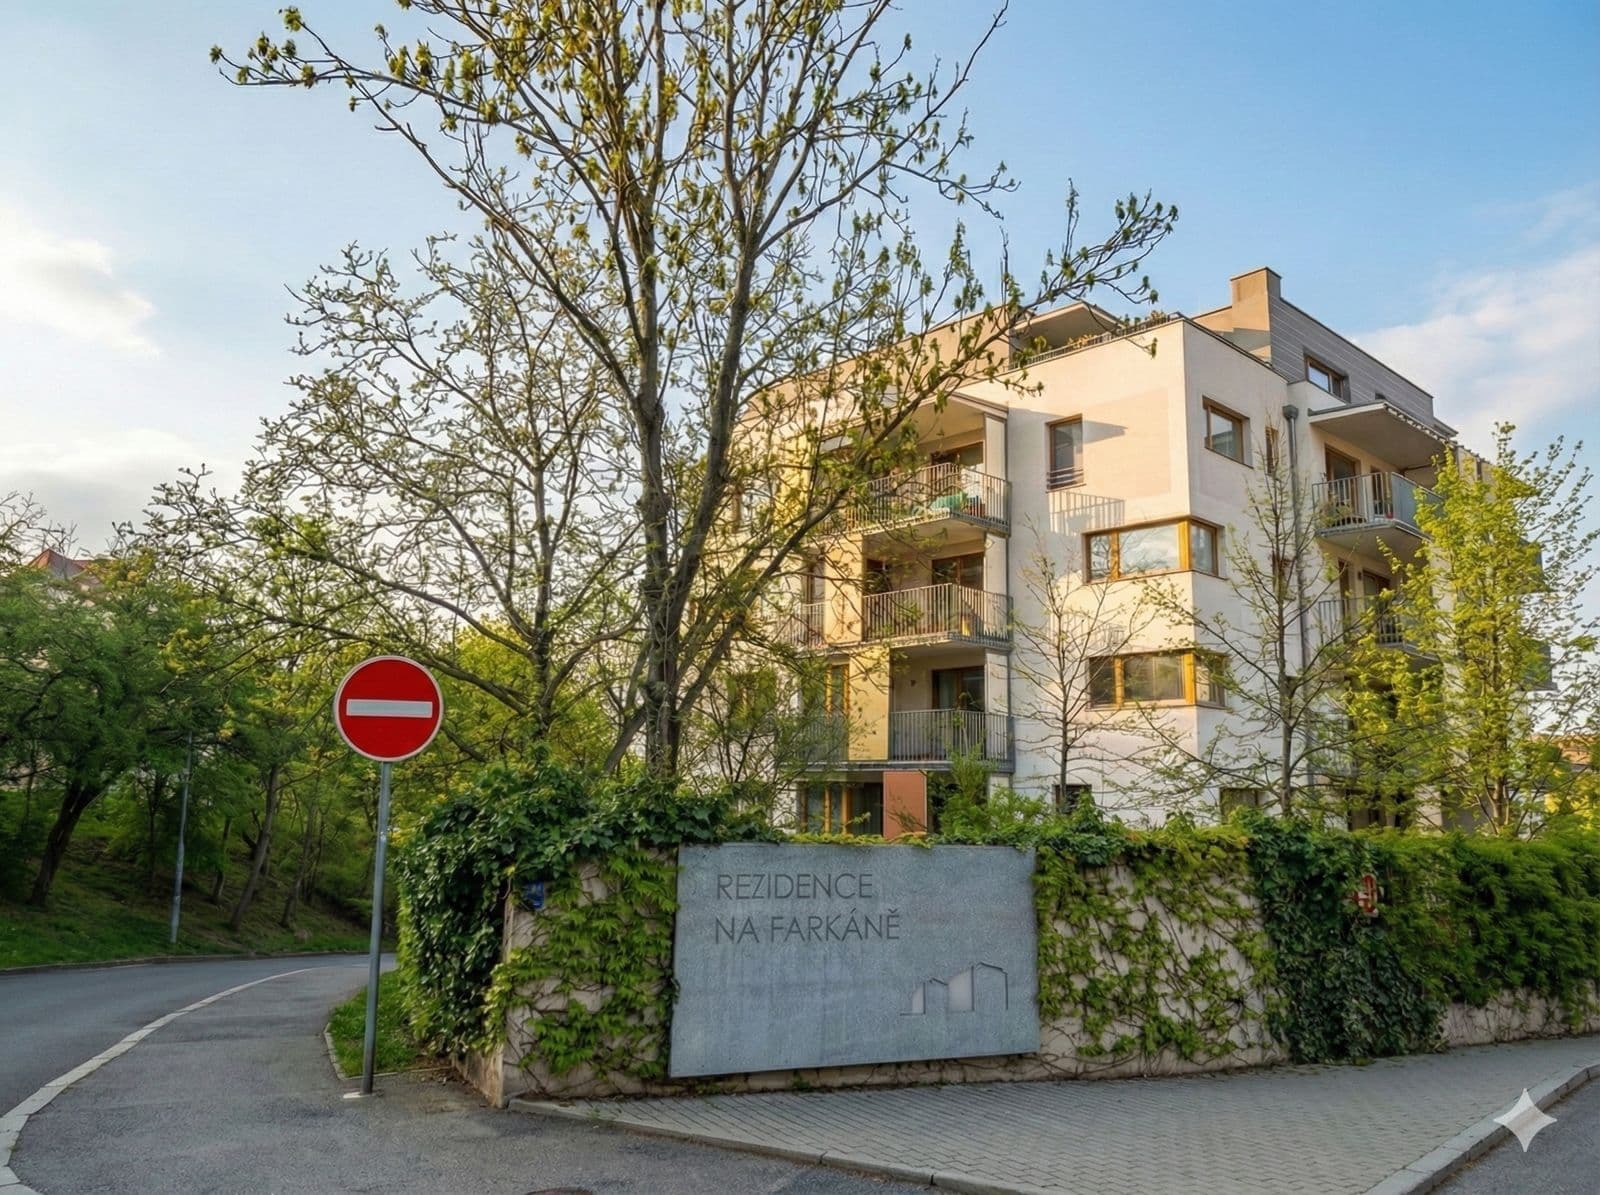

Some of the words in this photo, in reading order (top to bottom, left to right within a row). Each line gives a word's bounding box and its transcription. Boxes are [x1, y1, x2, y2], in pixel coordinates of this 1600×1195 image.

[717, 873, 873, 900] REZIDENCE
[715, 916, 760, 944] NA
[771, 907, 901, 942] FARKÁNĚ
